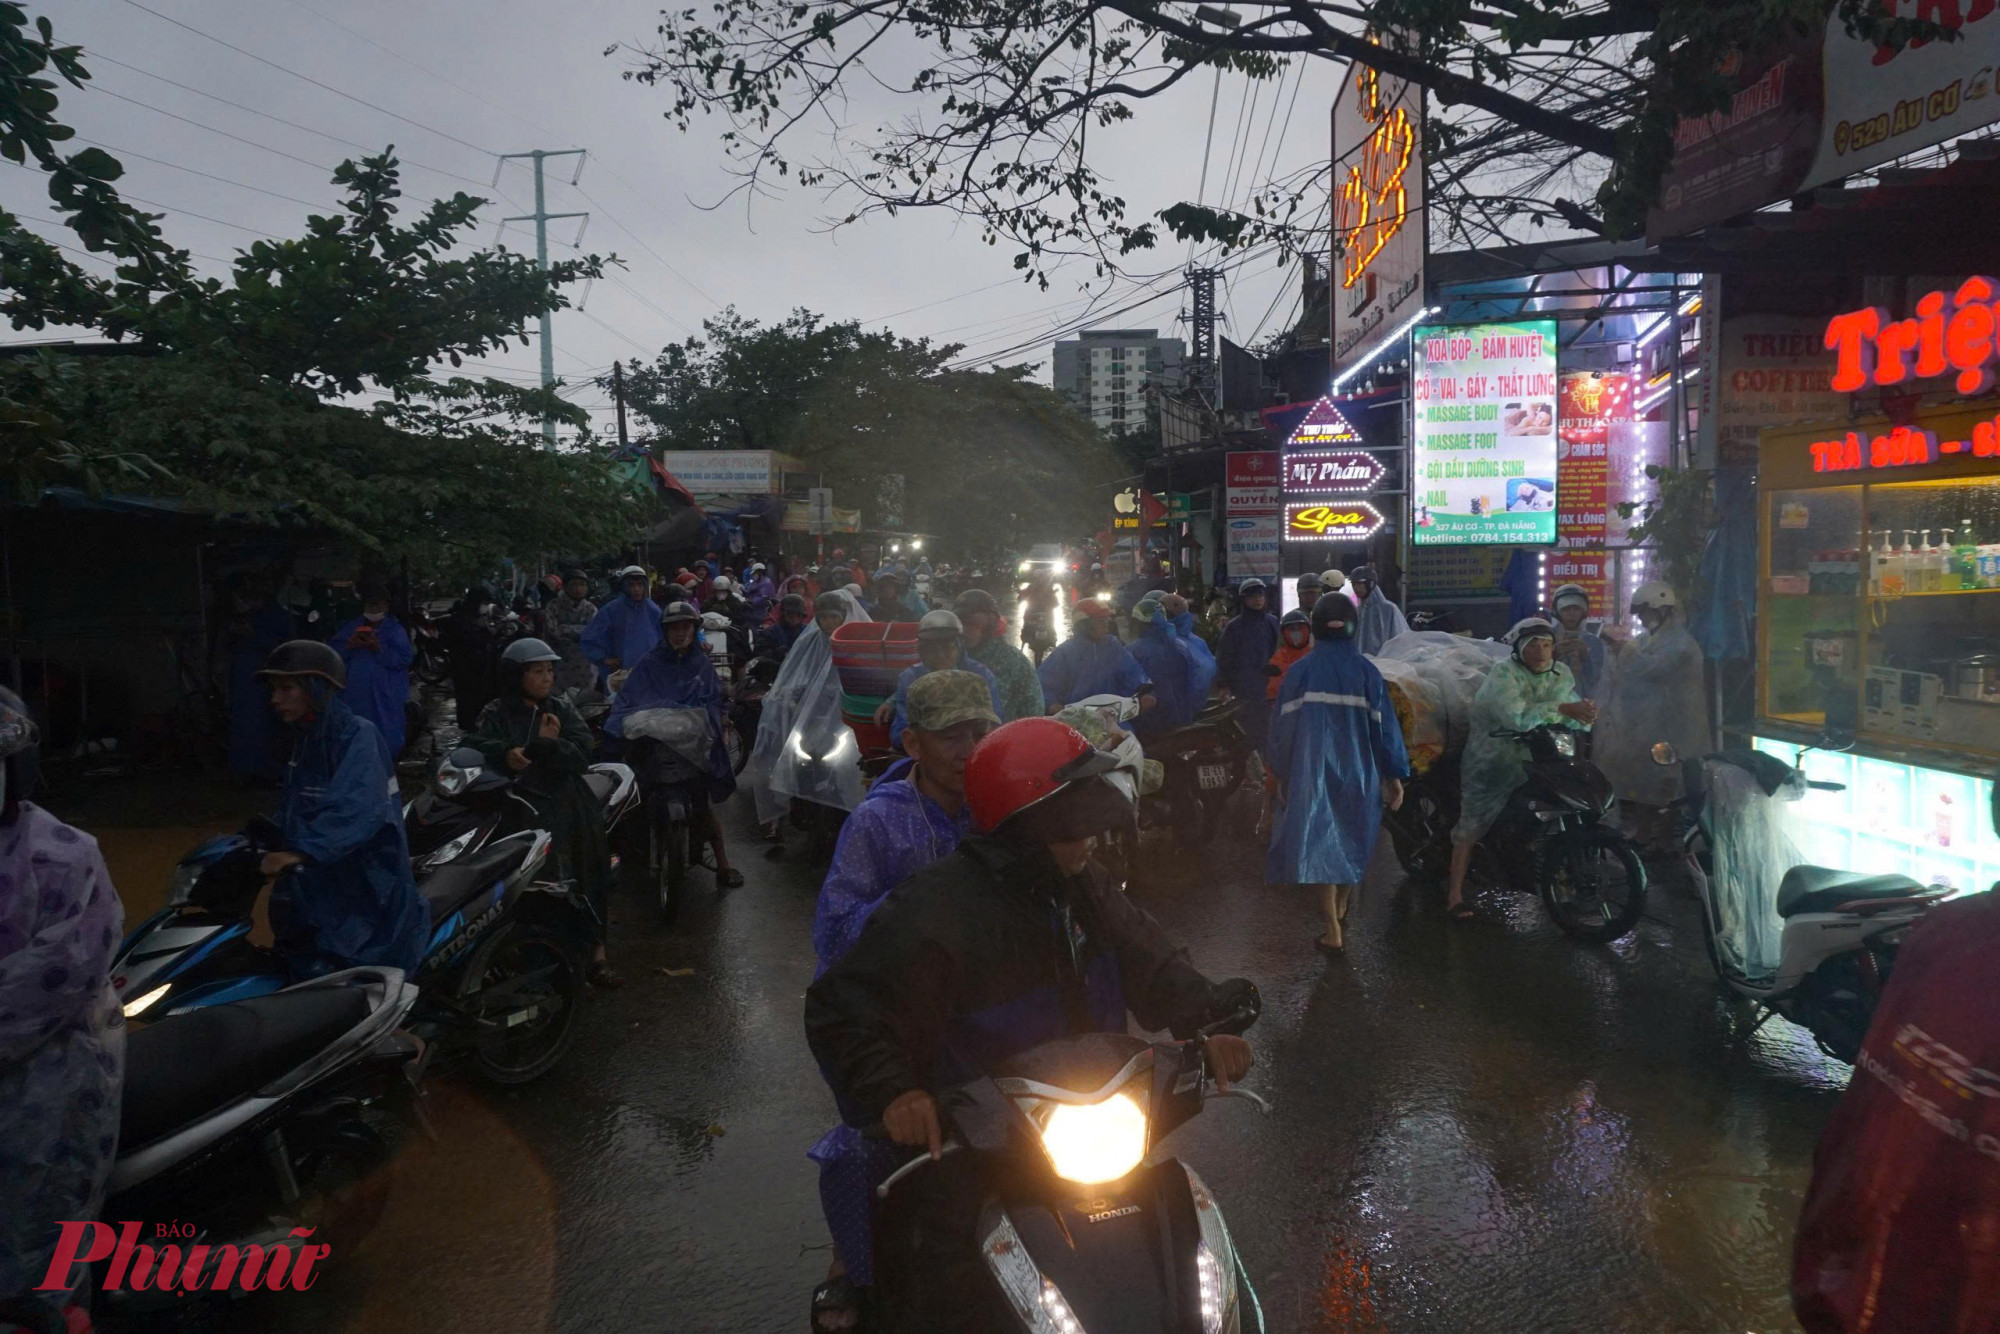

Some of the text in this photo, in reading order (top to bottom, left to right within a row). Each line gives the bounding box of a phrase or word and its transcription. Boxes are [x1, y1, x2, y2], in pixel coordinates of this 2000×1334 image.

[1851, 113, 1889, 151] 529
[1892, 97, 1924, 137] ÂU
[1927, 79, 1962, 122] CƠ
[1427, 328, 1543, 362] XOA BÓP BẤM HUYỆT
[1825, 275, 2000, 394] Triệ
[1440, 377, 1457, 400] VAI
[1467, 372, 1487, 398] GÁY
[1427, 404, 1499, 422] MASSAGE BODY
[1427, 432, 1498, 451] MASSAGE FOOT
[1810, 431, 1861, 473] TRÀ
[1290, 463, 1317, 485] Mỹ
[1427, 459, 1442, 482] GỘI
[1501, 460, 1525, 477] SINH
[1426, 490, 1448, 508] NAIL
[1290, 507, 1364, 533] Spa
[1436, 523, 1449, 531] 527
[1421, 532, 1549, 543] Hotline: 0784.154.313
[428, 900, 504, 970] PETRONAS
[1088, 1205, 1142, 1223] HONDA
